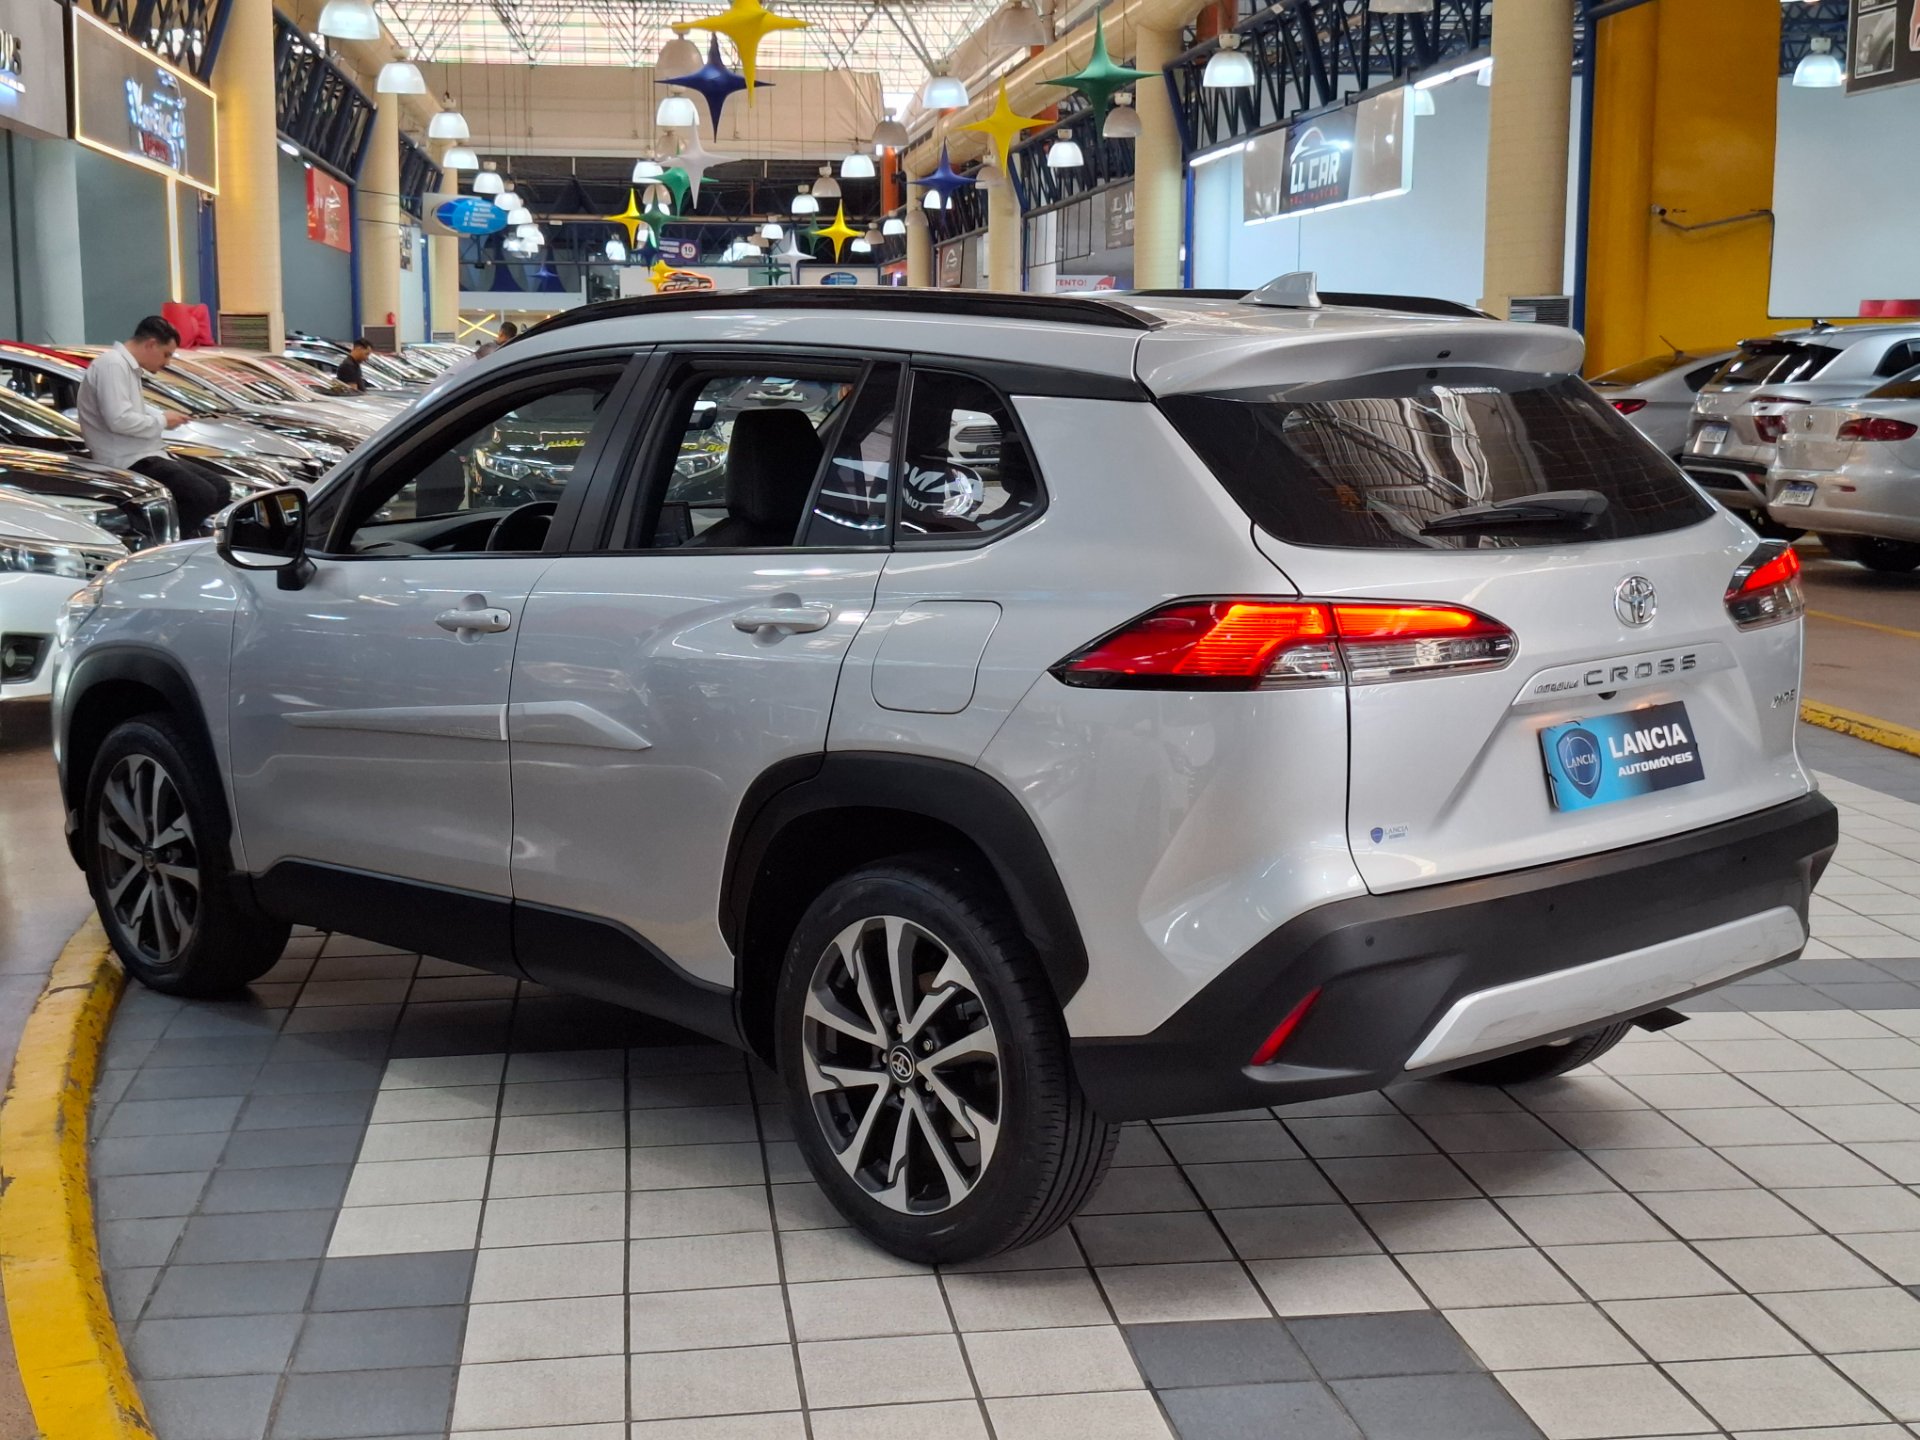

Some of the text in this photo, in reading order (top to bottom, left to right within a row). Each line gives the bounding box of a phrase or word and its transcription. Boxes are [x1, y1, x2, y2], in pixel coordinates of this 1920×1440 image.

[1308, 150, 1340, 190] CAR
[1056, 278, 1087, 287] TENTO!
[1583, 653, 1696, 687] CROSS
[1608, 722, 1688, 759] LANCIA
[1565, 754, 1597, 769] LANCIA
[1618, 751, 1694, 777] AUTOMÓVEIS
